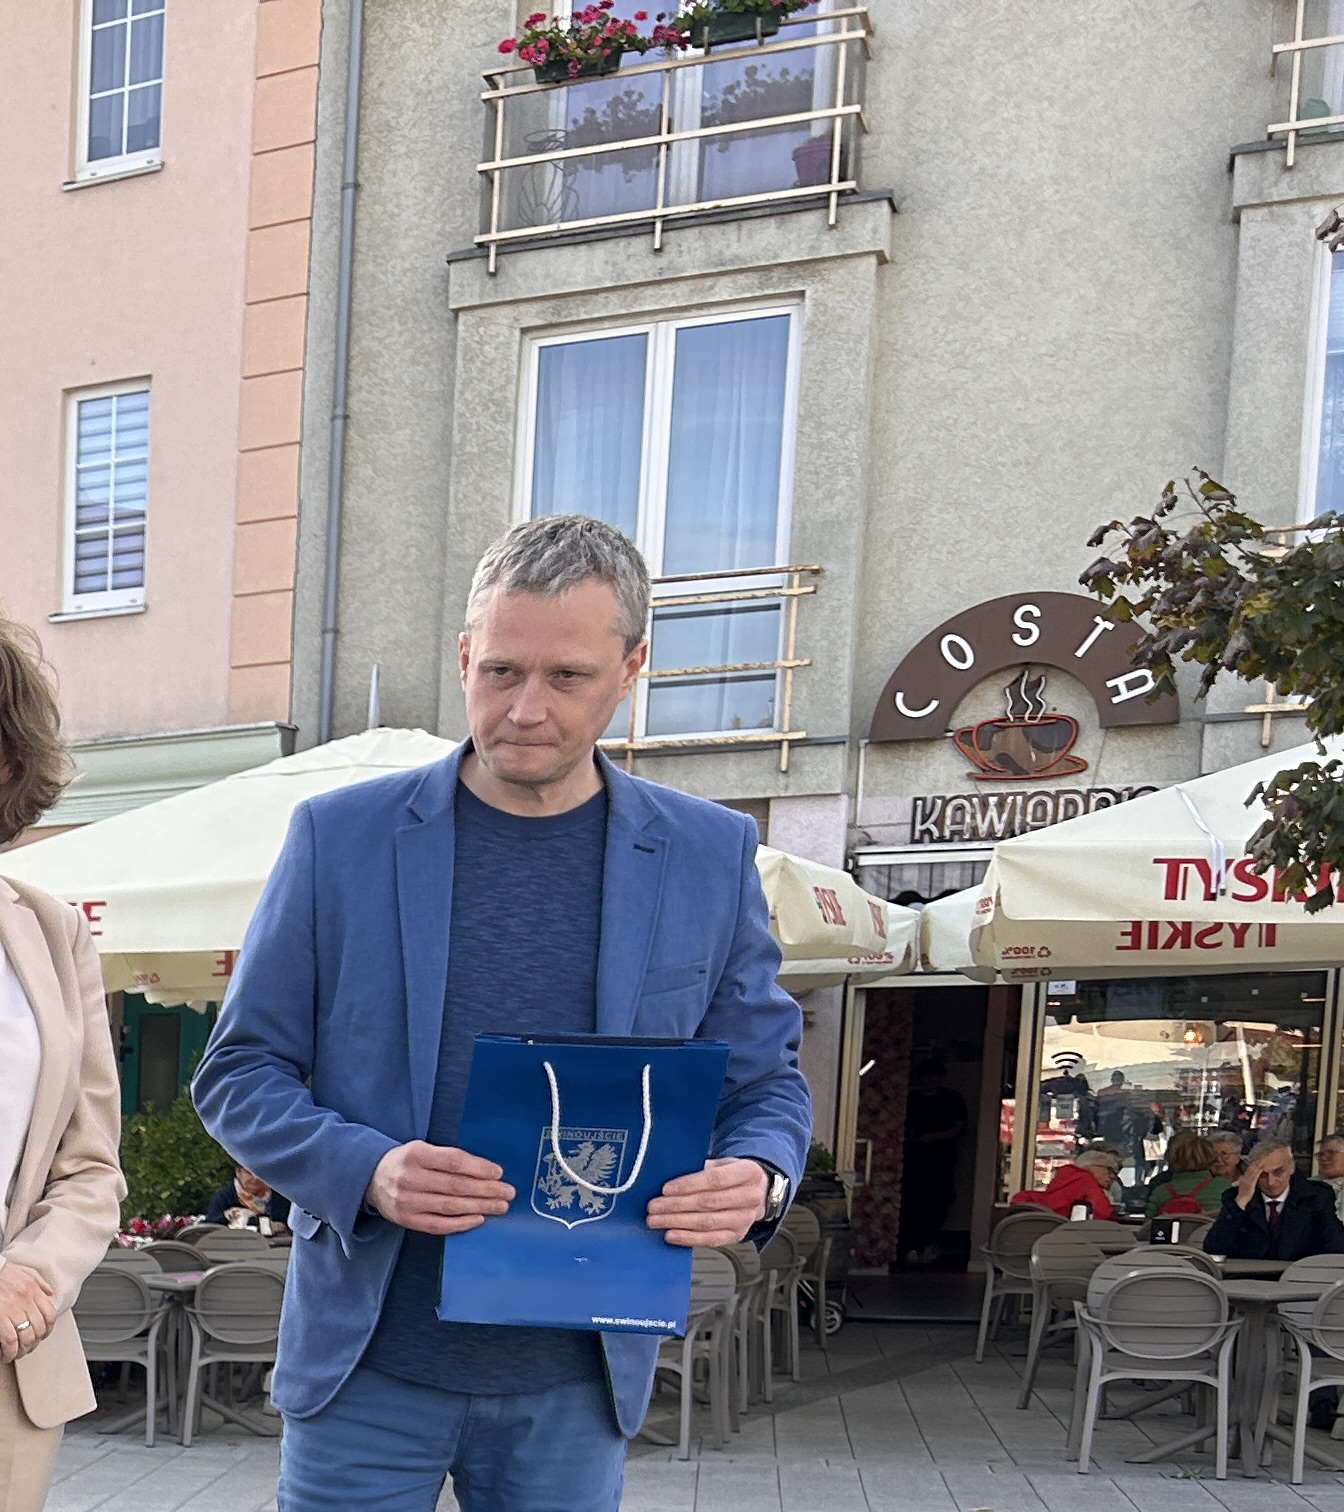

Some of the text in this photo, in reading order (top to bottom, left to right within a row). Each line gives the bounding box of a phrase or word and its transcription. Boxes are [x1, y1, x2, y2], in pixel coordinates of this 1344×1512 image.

[895, 604, 1155, 718] COSTA
[912, 787, 1160, 842] KAWIAR
[591, 1316, 676, 1329] www.swinoujscie.pl
